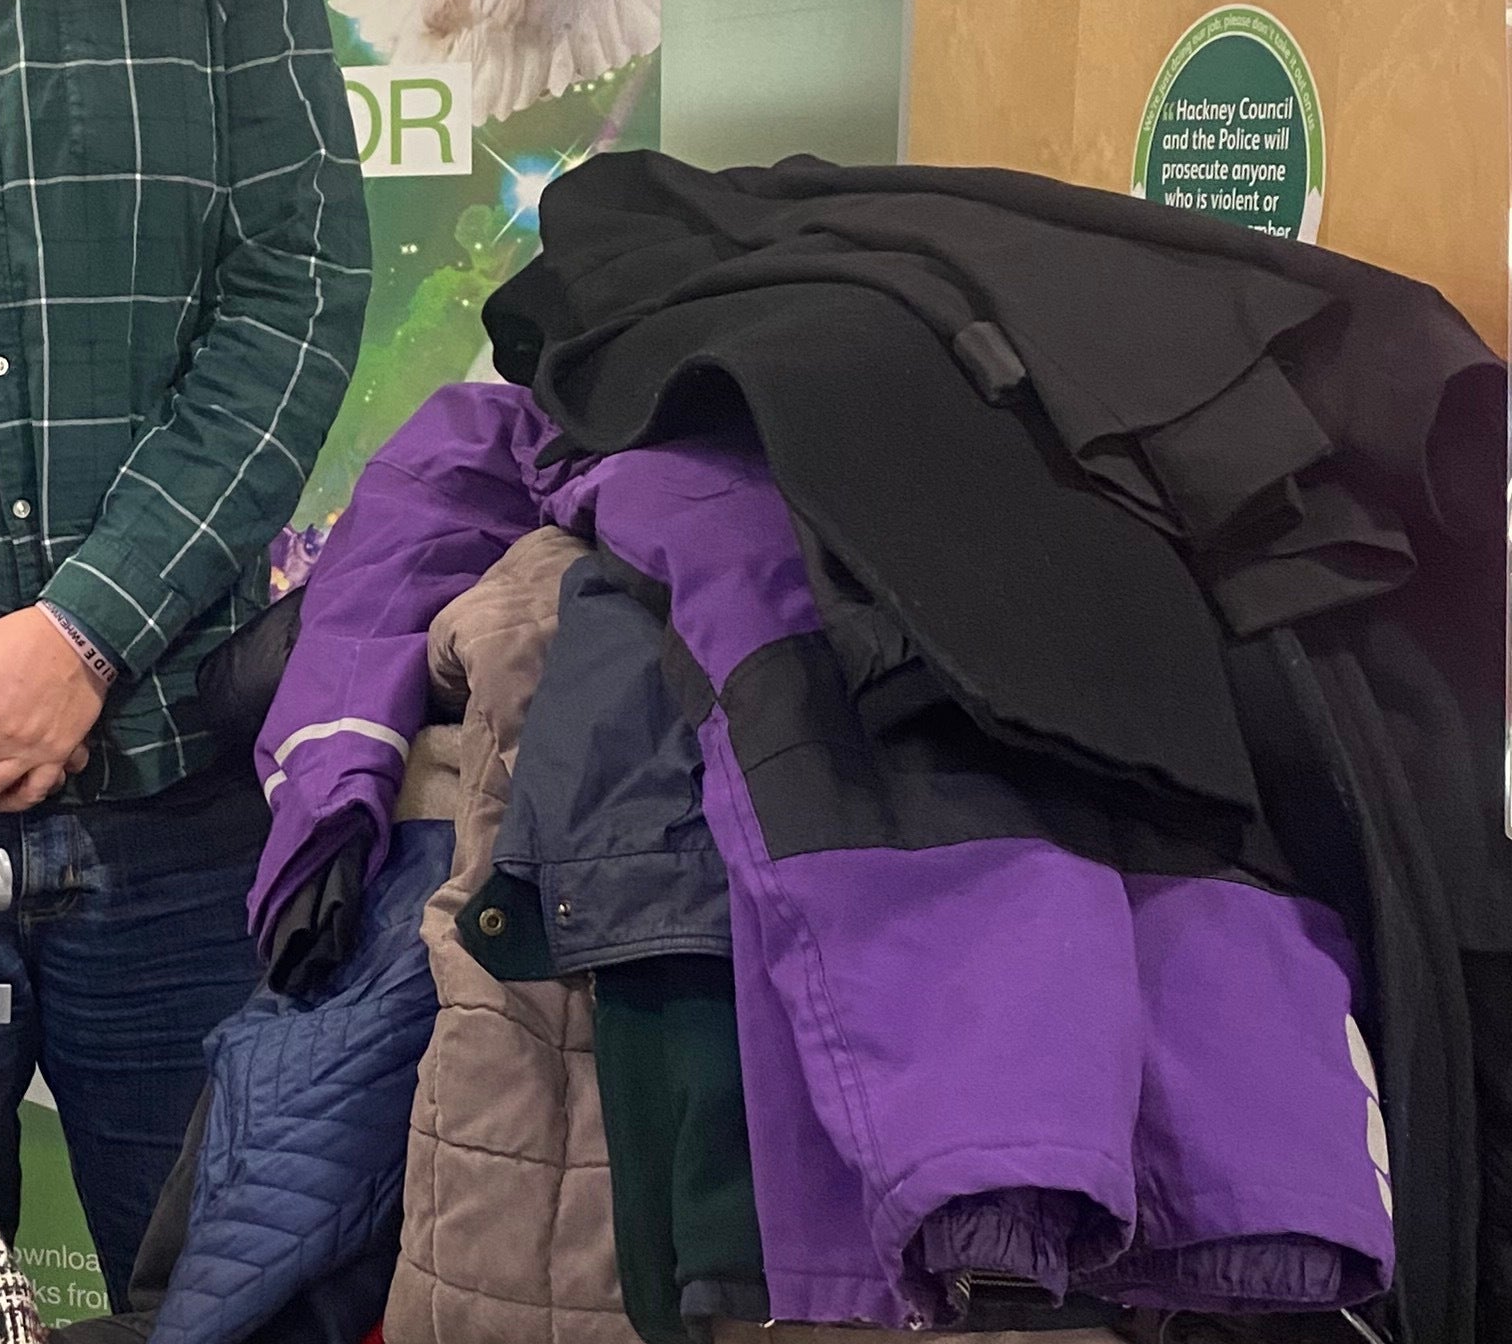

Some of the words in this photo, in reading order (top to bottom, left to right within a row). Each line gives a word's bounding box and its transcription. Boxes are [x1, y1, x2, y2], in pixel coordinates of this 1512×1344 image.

[1293, 67, 1308, 92] out
[1238, 96, 1294, 121] Council
[1303, 91, 1313, 113] on
[1307, 113, 1317, 132] us
[1162, 127, 1189, 150] and
[1192, 128, 1216, 151] the
[1218, 127, 1261, 151] Police
[1264, 126, 1290, 151] will
[1162, 159, 1229, 186] prosecute
[1231, 163, 1287, 187] anyone
[1164, 186, 1194, 209] who
[1195, 187, 1208, 210] is
[1210, 186, 1260, 212] violent
[1262, 194, 1280, 213] or
